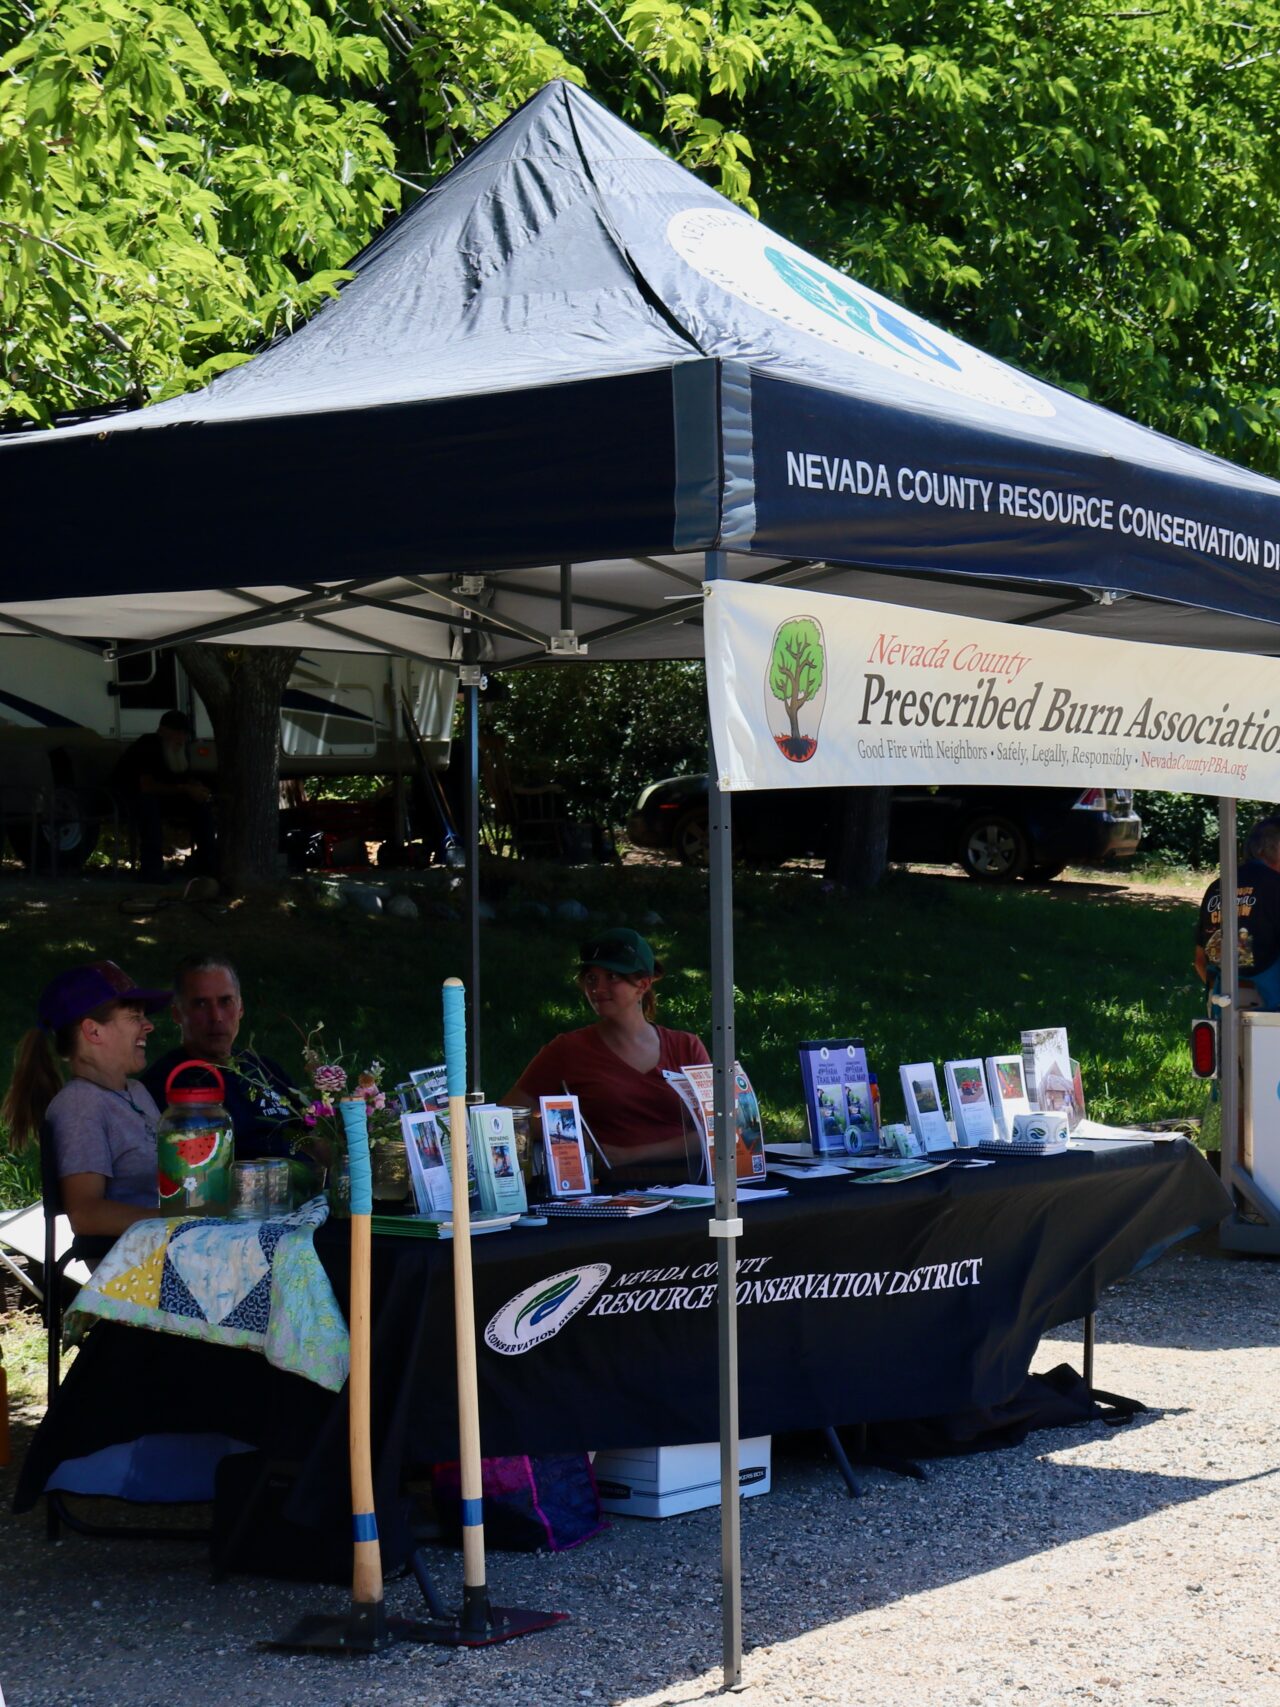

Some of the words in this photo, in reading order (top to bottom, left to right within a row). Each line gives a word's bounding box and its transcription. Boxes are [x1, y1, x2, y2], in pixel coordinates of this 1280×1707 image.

[786, 450, 892, 498] NEVADA
[897, 467, 993, 512] COUNTY
[999, 483, 1114, 531] RESOURCE
[1118, 503, 1260, 565] CONSERVATION
[866, 633, 951, 670] Nevada
[952, 643, 1033, 684] County
[857, 673, 1044, 731] Prescribed
[1038, 687, 1125, 737] Burn
[857, 738, 884, 760] Good
[886, 739, 908, 759] Fire
[909, 740, 935, 760] with
[936, 740, 988, 765] Neighbors
[997, 741, 1030, 766] Safely,
[1031, 743, 1070, 768] Legally,
[1071, 746, 1133, 771] Responsibly
[1140, 751, 1249, 780] NevadaCountyPBA.org
[587, 1283, 718, 1317] RESOURCE
[717, 1271, 890, 1306] ONSERVATION
[886, 1257, 983, 1295] DISTRICT
[611, 1265, 690, 1288] NEVADA
[691, 1256, 773, 1279] CONTY
[488, 1327, 557, 1354] CONSERVATION
